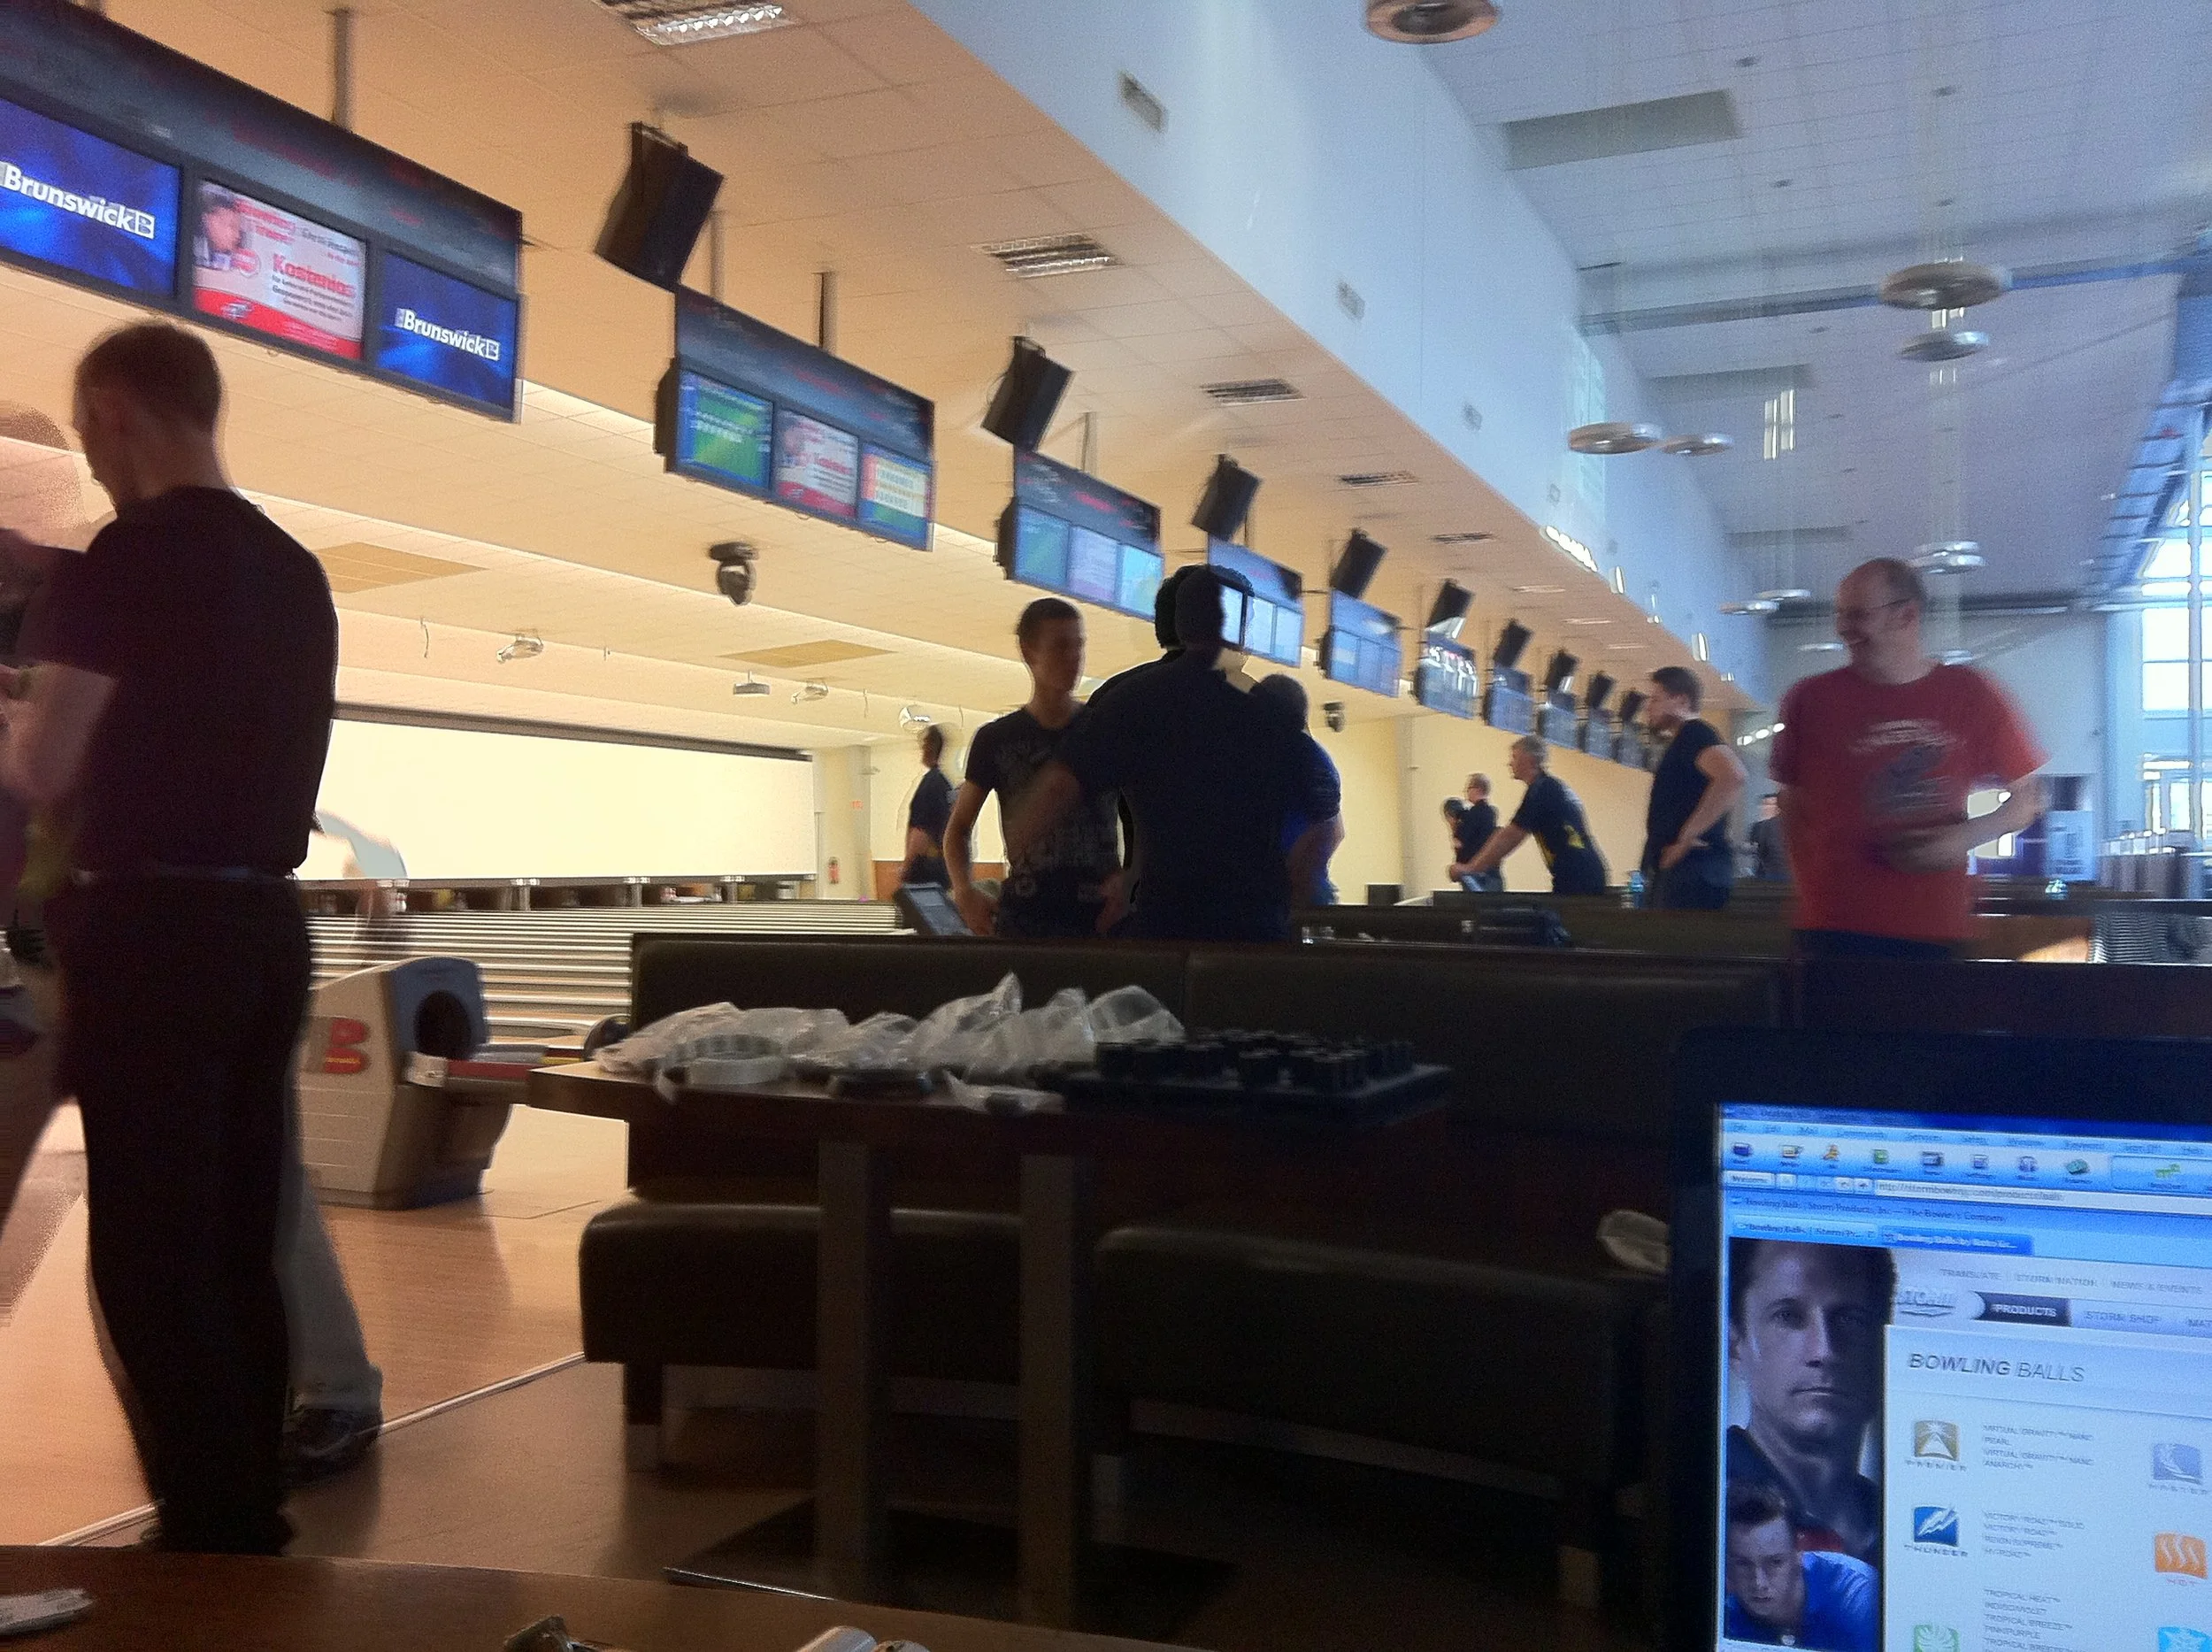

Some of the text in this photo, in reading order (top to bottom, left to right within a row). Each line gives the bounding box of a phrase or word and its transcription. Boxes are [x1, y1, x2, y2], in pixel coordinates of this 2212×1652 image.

[4, 164, 134, 233] Brunswick
[403, 309, 485, 357] Brunswick
[1994, 1303, 2057, 1318] PRODUCTS
[1909, 1353, 2086, 1383] BOWLING BALLS
